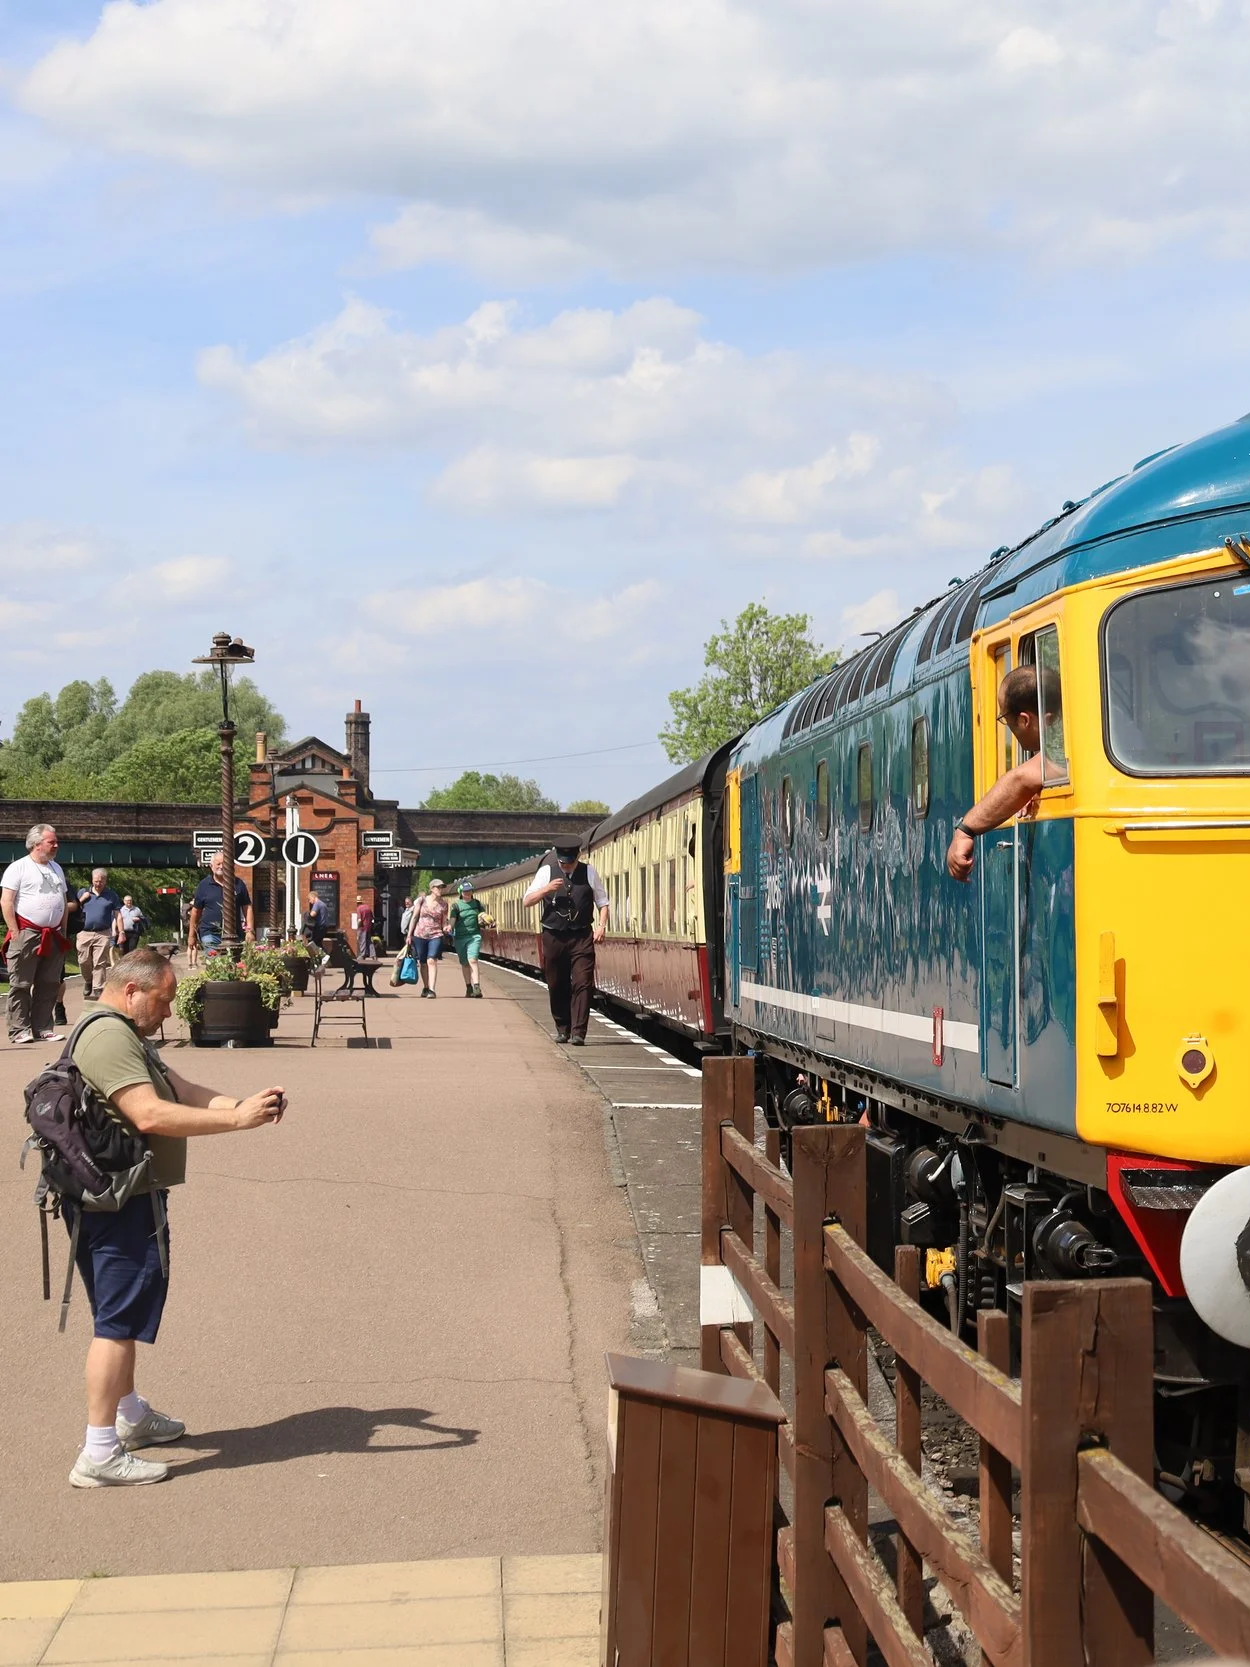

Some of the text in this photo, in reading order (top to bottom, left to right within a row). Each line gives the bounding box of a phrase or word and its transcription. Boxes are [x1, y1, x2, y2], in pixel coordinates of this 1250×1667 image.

[238, 836, 255, 861] 2
[297, 837, 305, 862] 1
[149, 1421, 159, 1430] N
